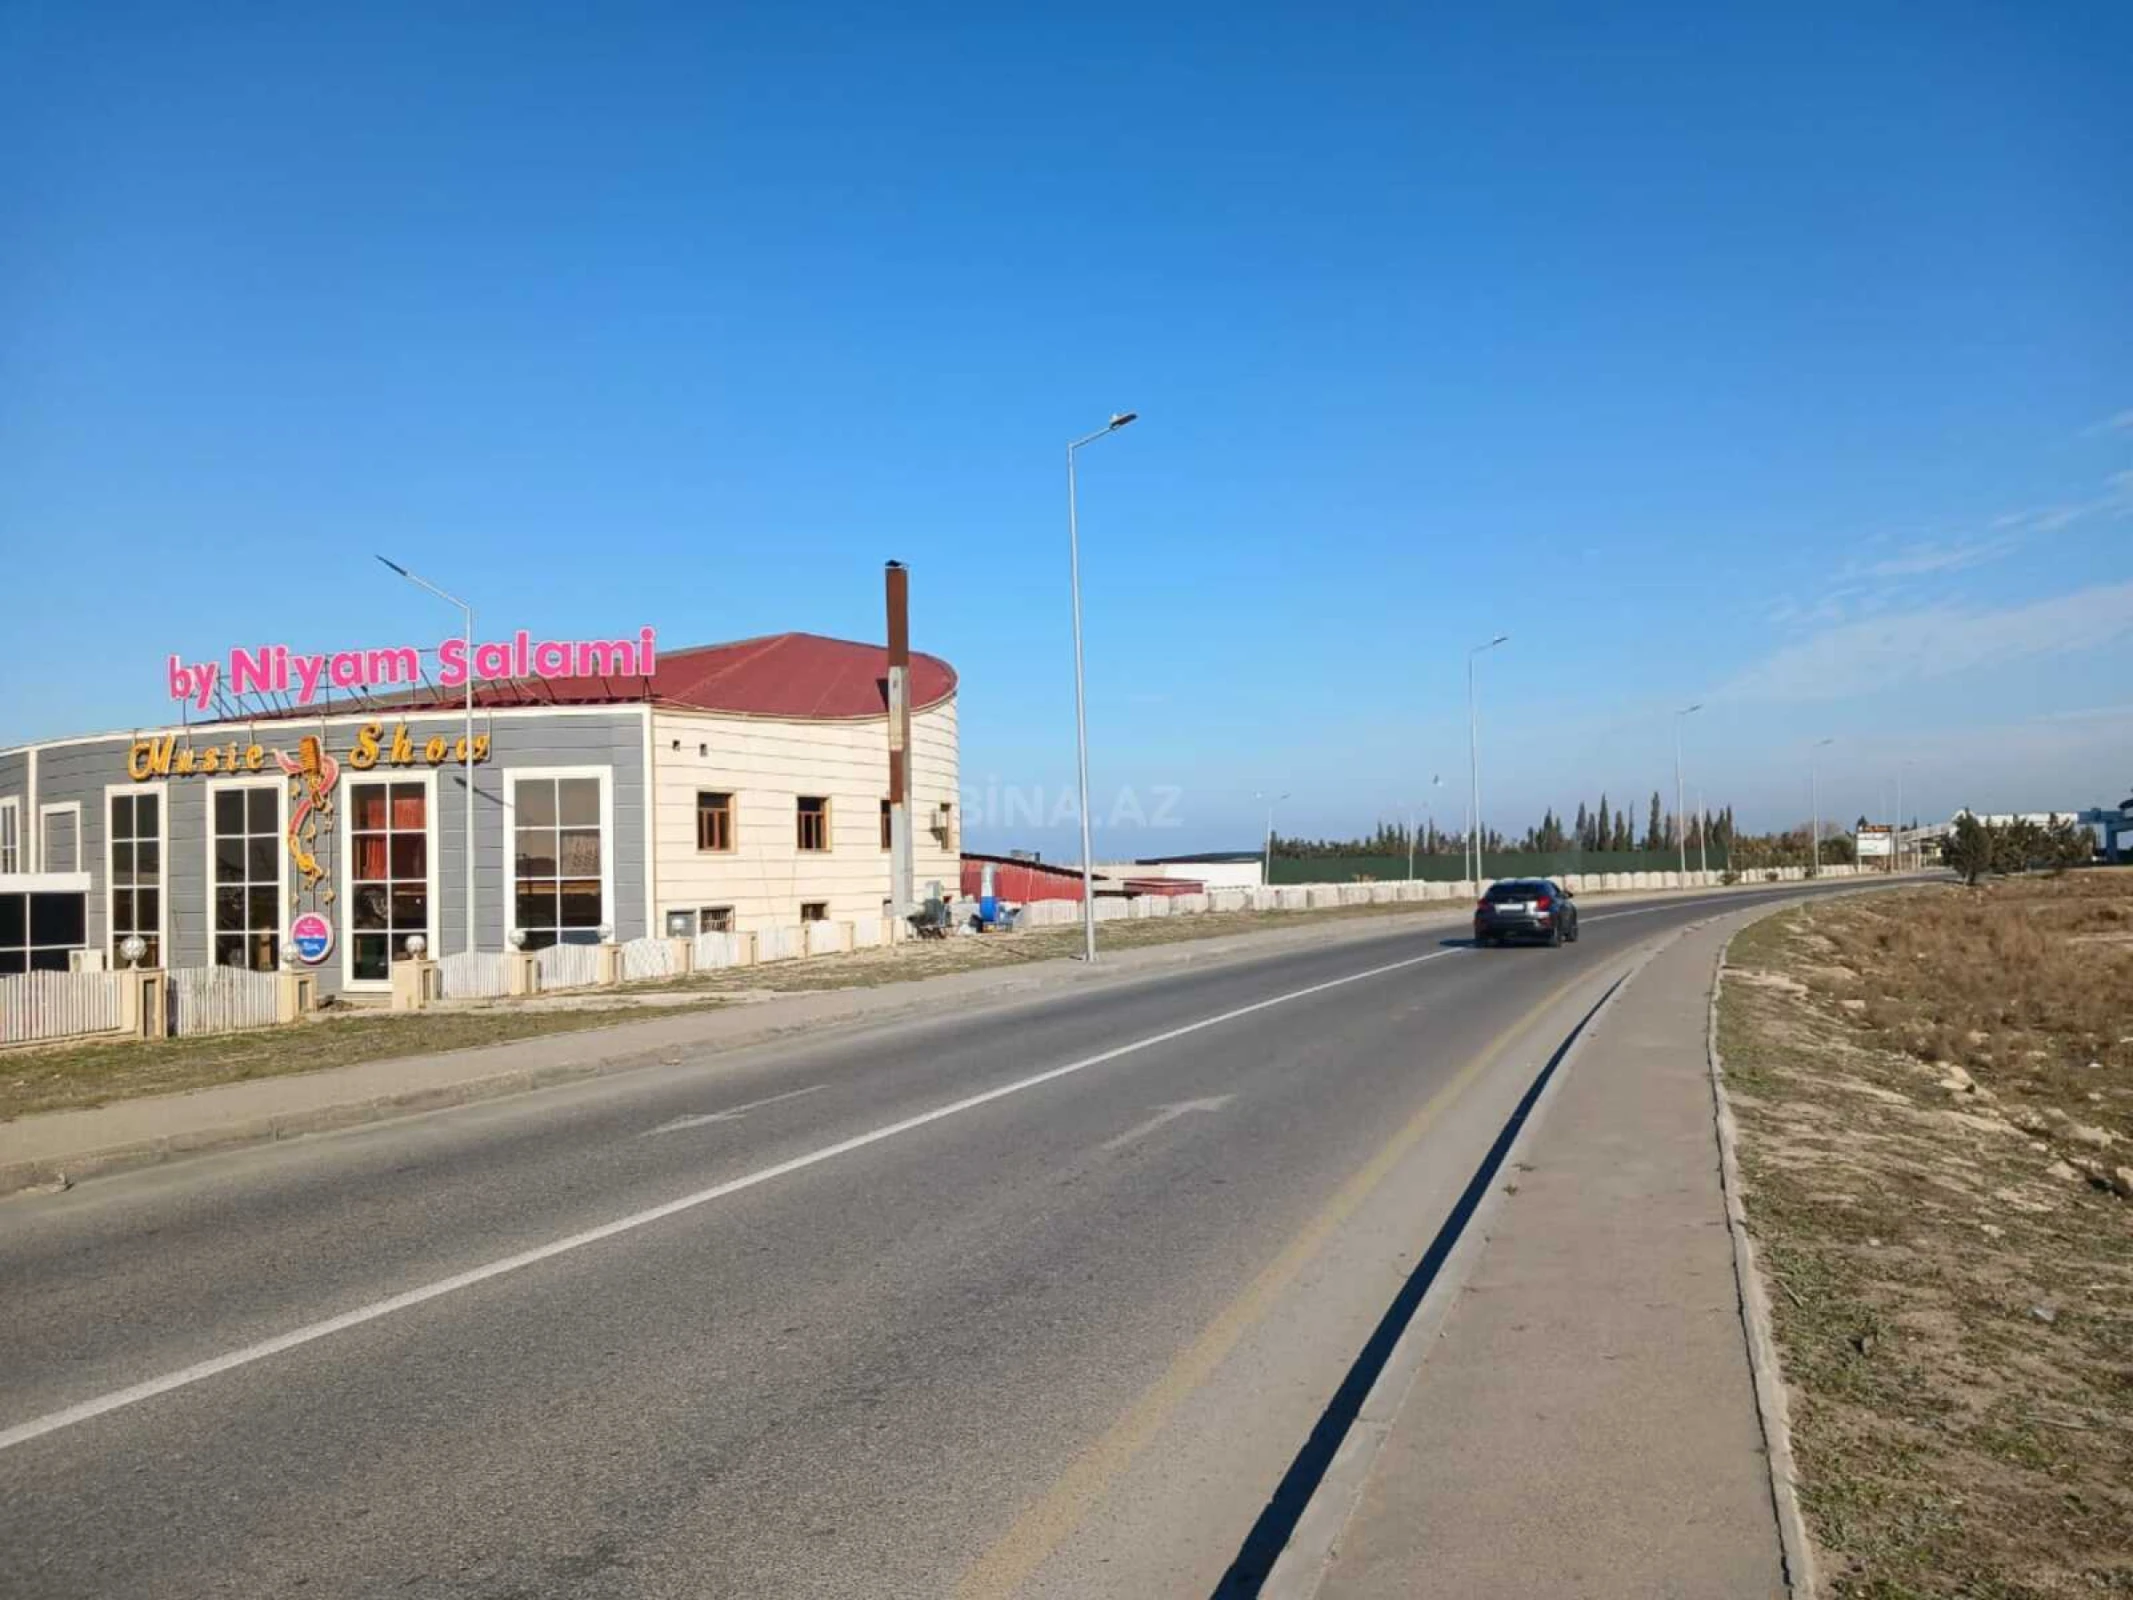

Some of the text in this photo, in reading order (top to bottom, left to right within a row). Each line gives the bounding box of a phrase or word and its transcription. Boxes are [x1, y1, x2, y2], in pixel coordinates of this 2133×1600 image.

[168, 625, 657, 712] by Niyam Salami
[349, 720, 491, 769] Show
